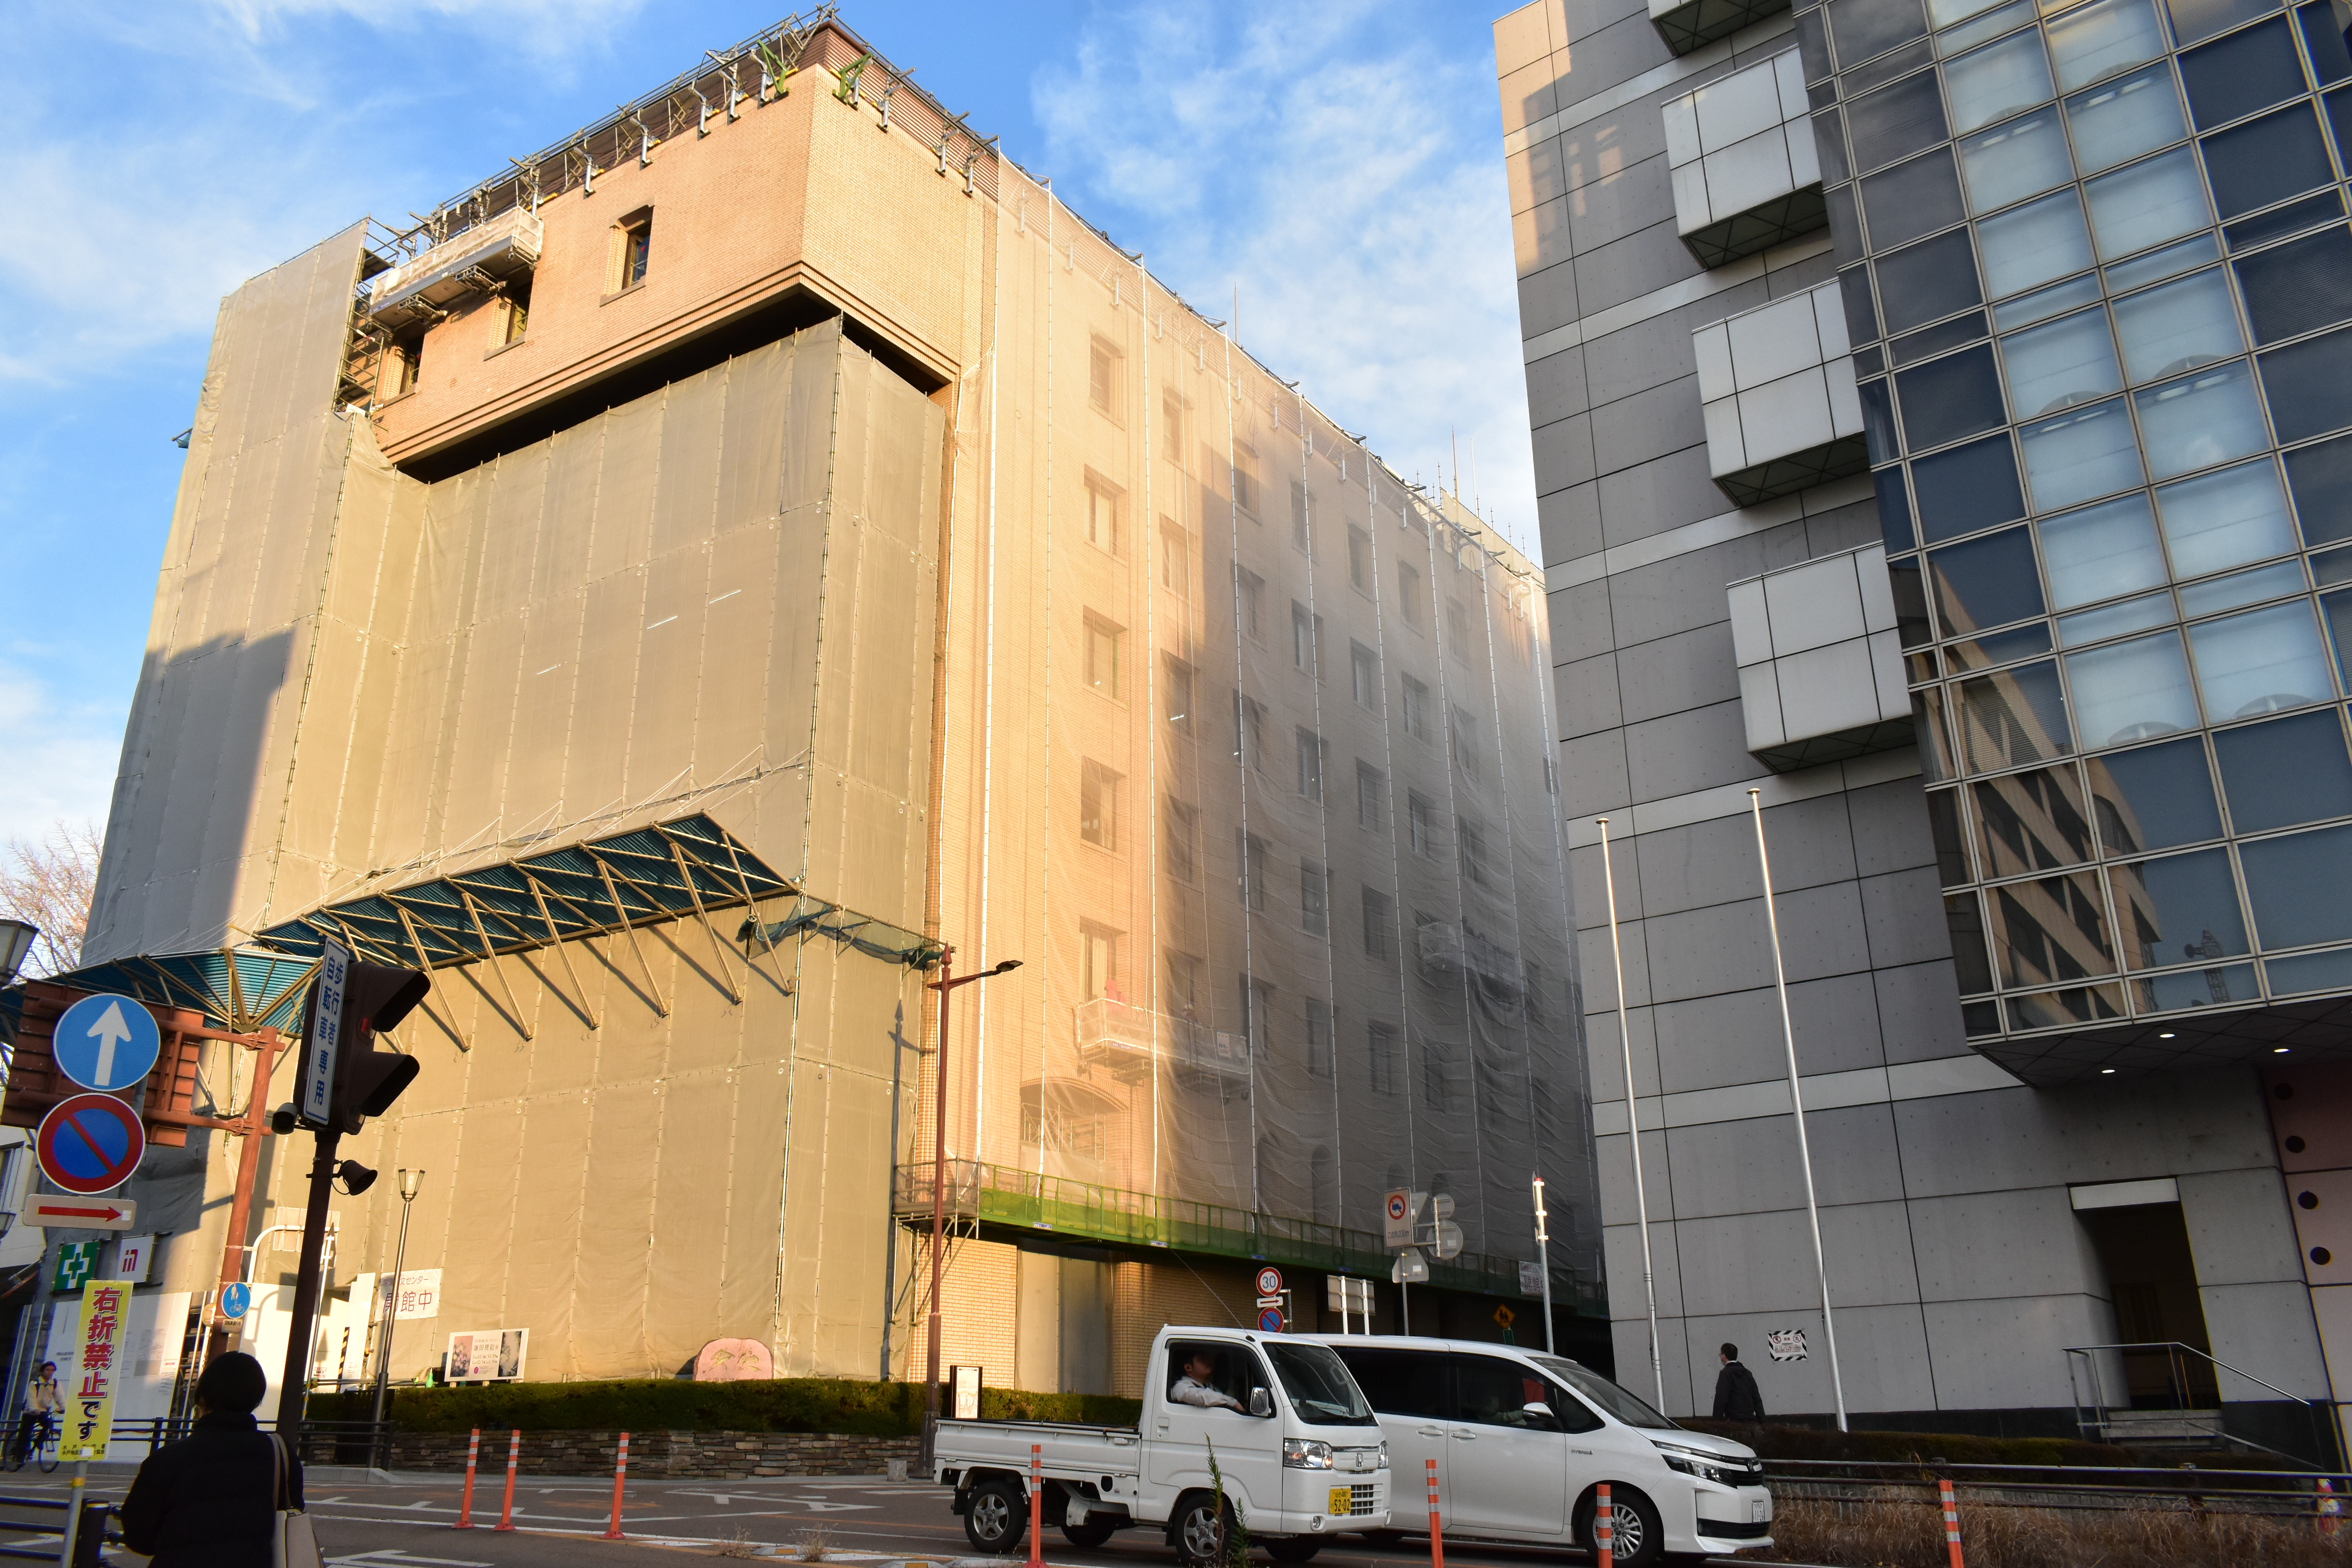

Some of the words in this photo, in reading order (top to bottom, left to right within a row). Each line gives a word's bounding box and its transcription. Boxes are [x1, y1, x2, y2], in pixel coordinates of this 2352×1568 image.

[328, 962, 343, 1046] 歩行者
[315, 1049, 328, 1105] 専用
[383, 1290, 432, 1313] 開館中
[1263, 1276, 1276, 1289] 30
[78, 1287, 122, 1441] 右折禁止です
